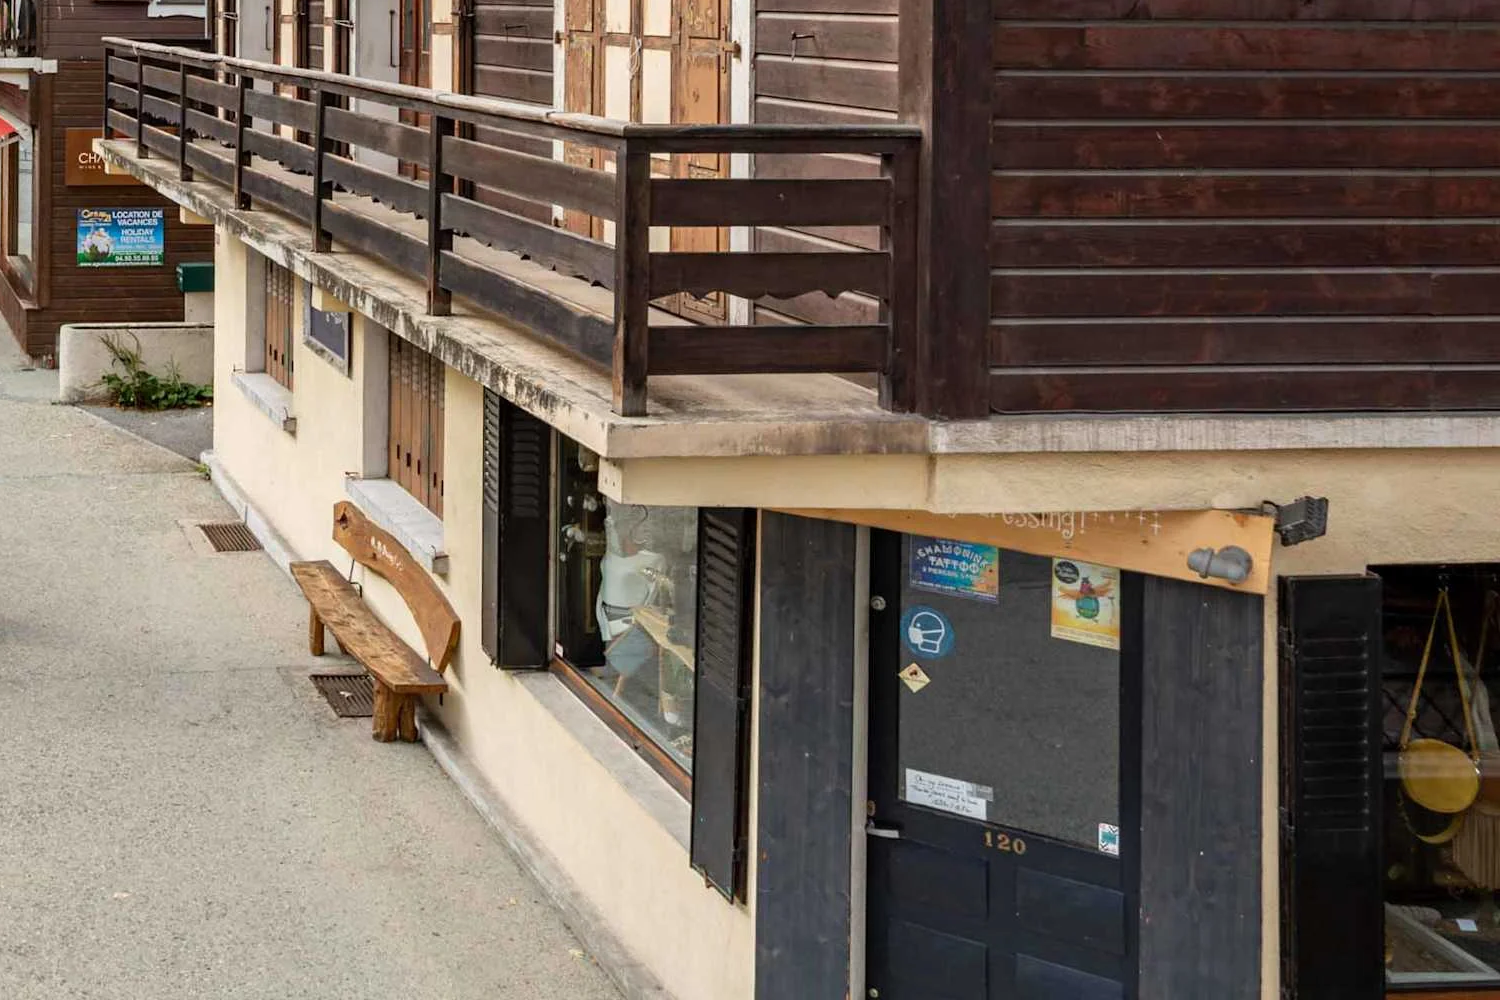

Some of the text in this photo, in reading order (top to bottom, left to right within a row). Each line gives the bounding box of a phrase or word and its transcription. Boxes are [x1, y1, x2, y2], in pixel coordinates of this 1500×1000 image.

[112, 210, 163, 218] LOCATION DE
[121, 228, 154, 236] HOLIDAY
[928, 556, 979, 574] TATTOO
[984, 831, 1026, 855] 120
